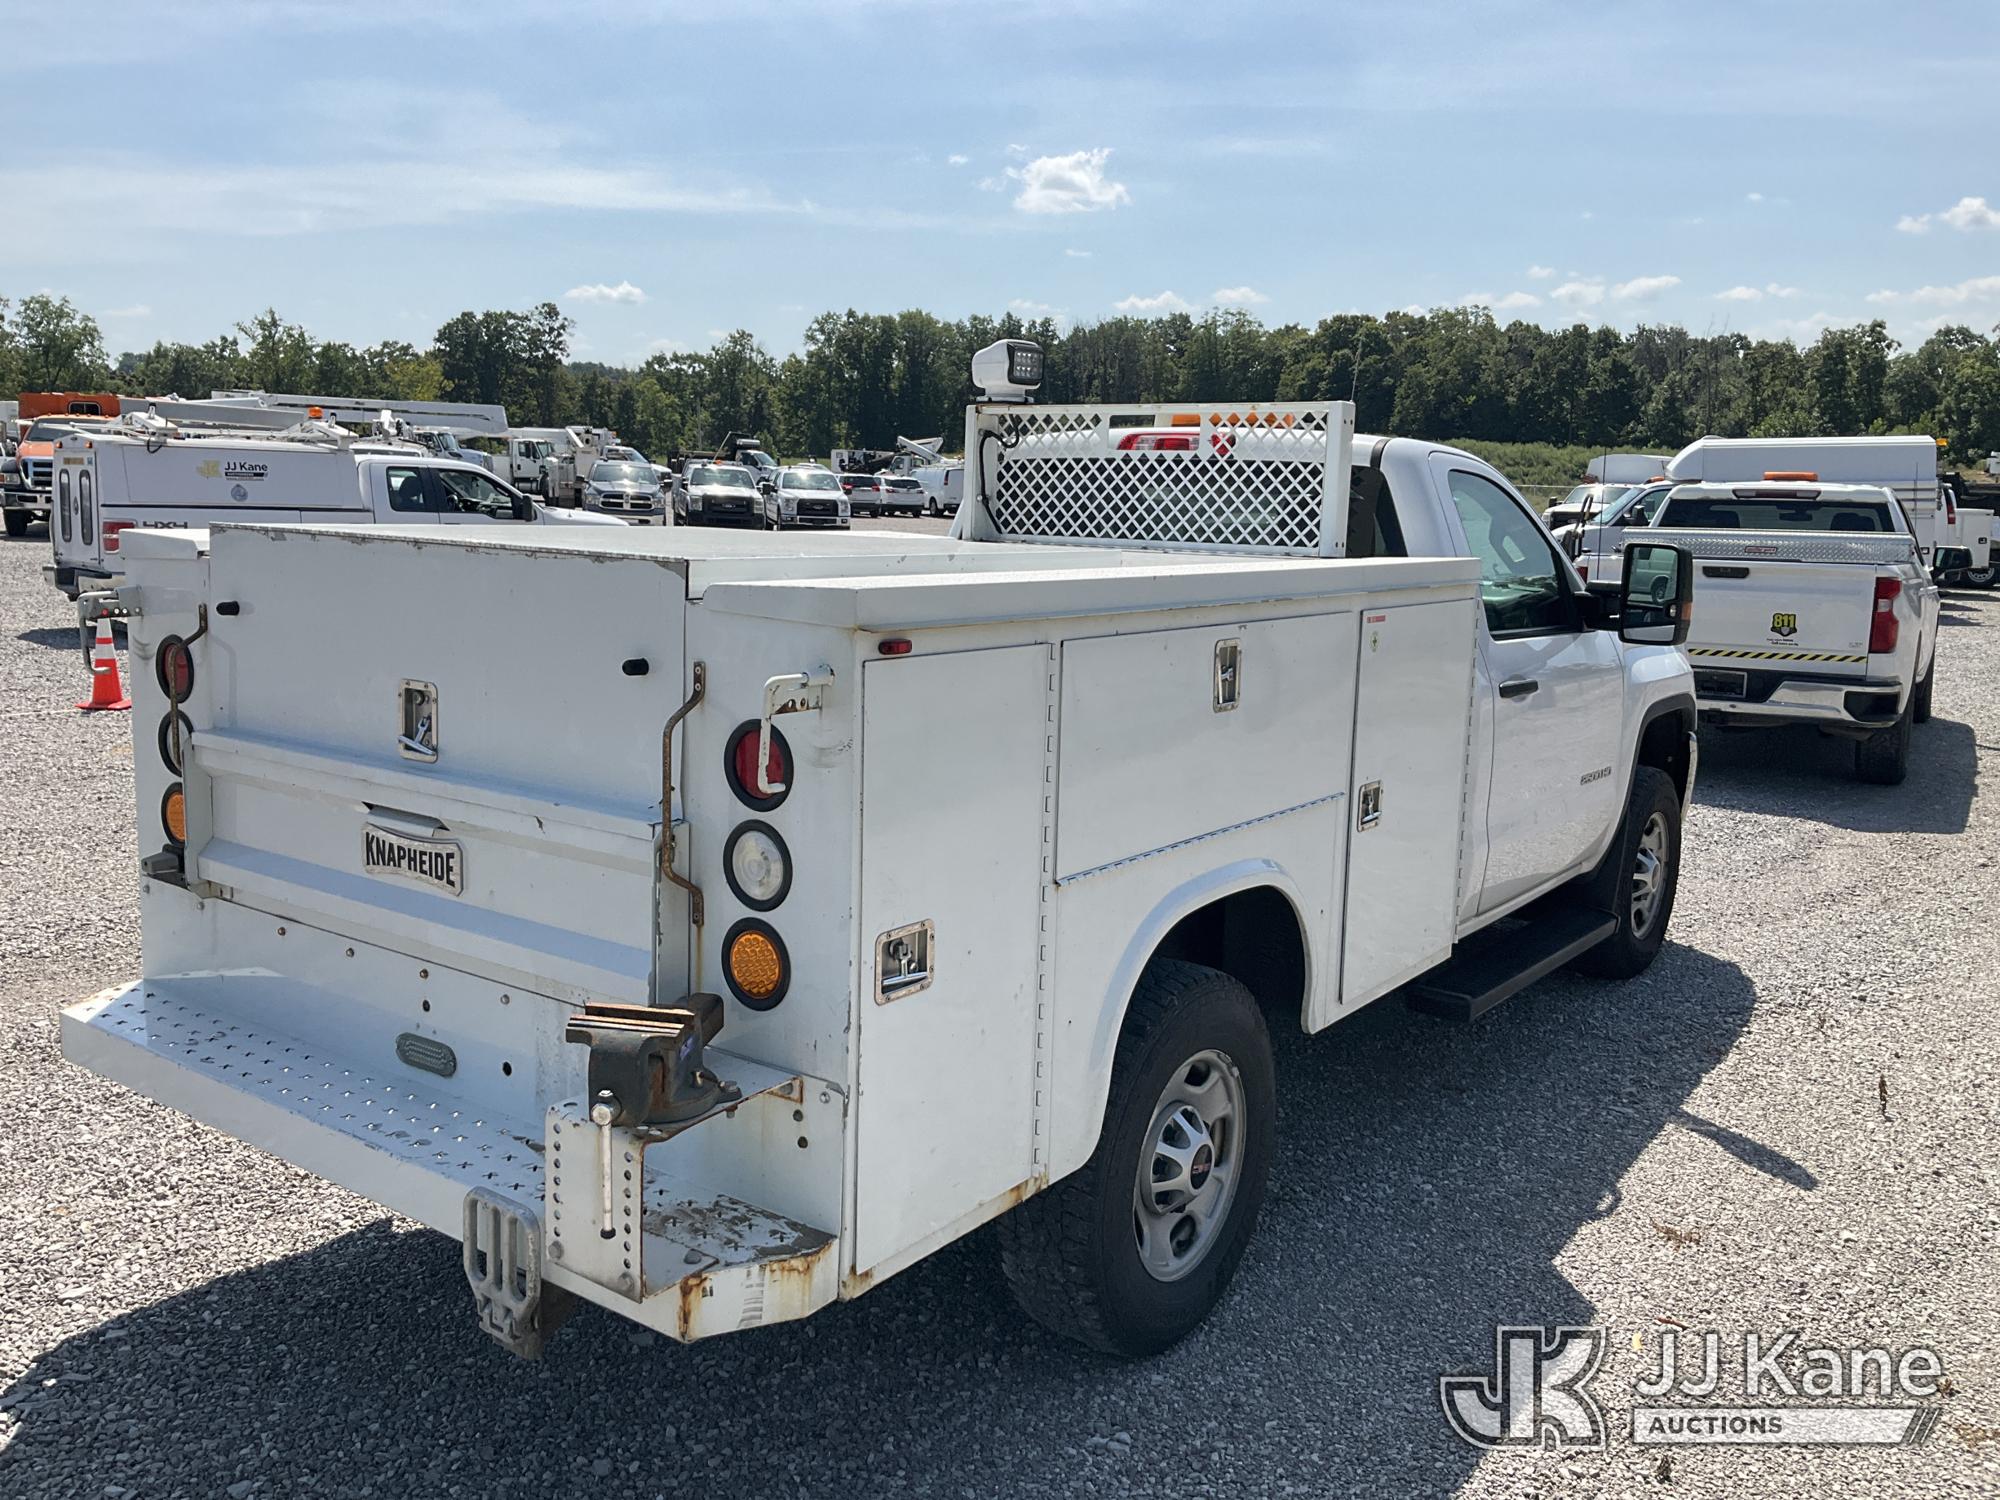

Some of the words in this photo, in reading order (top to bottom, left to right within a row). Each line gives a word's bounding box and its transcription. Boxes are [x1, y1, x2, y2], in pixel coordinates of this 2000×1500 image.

[225, 461, 237, 471] JJ
[239, 461, 268, 472] Kane
[1773, 613, 1796, 629] 811
[365, 831, 455, 888] KNAPHEIDE
